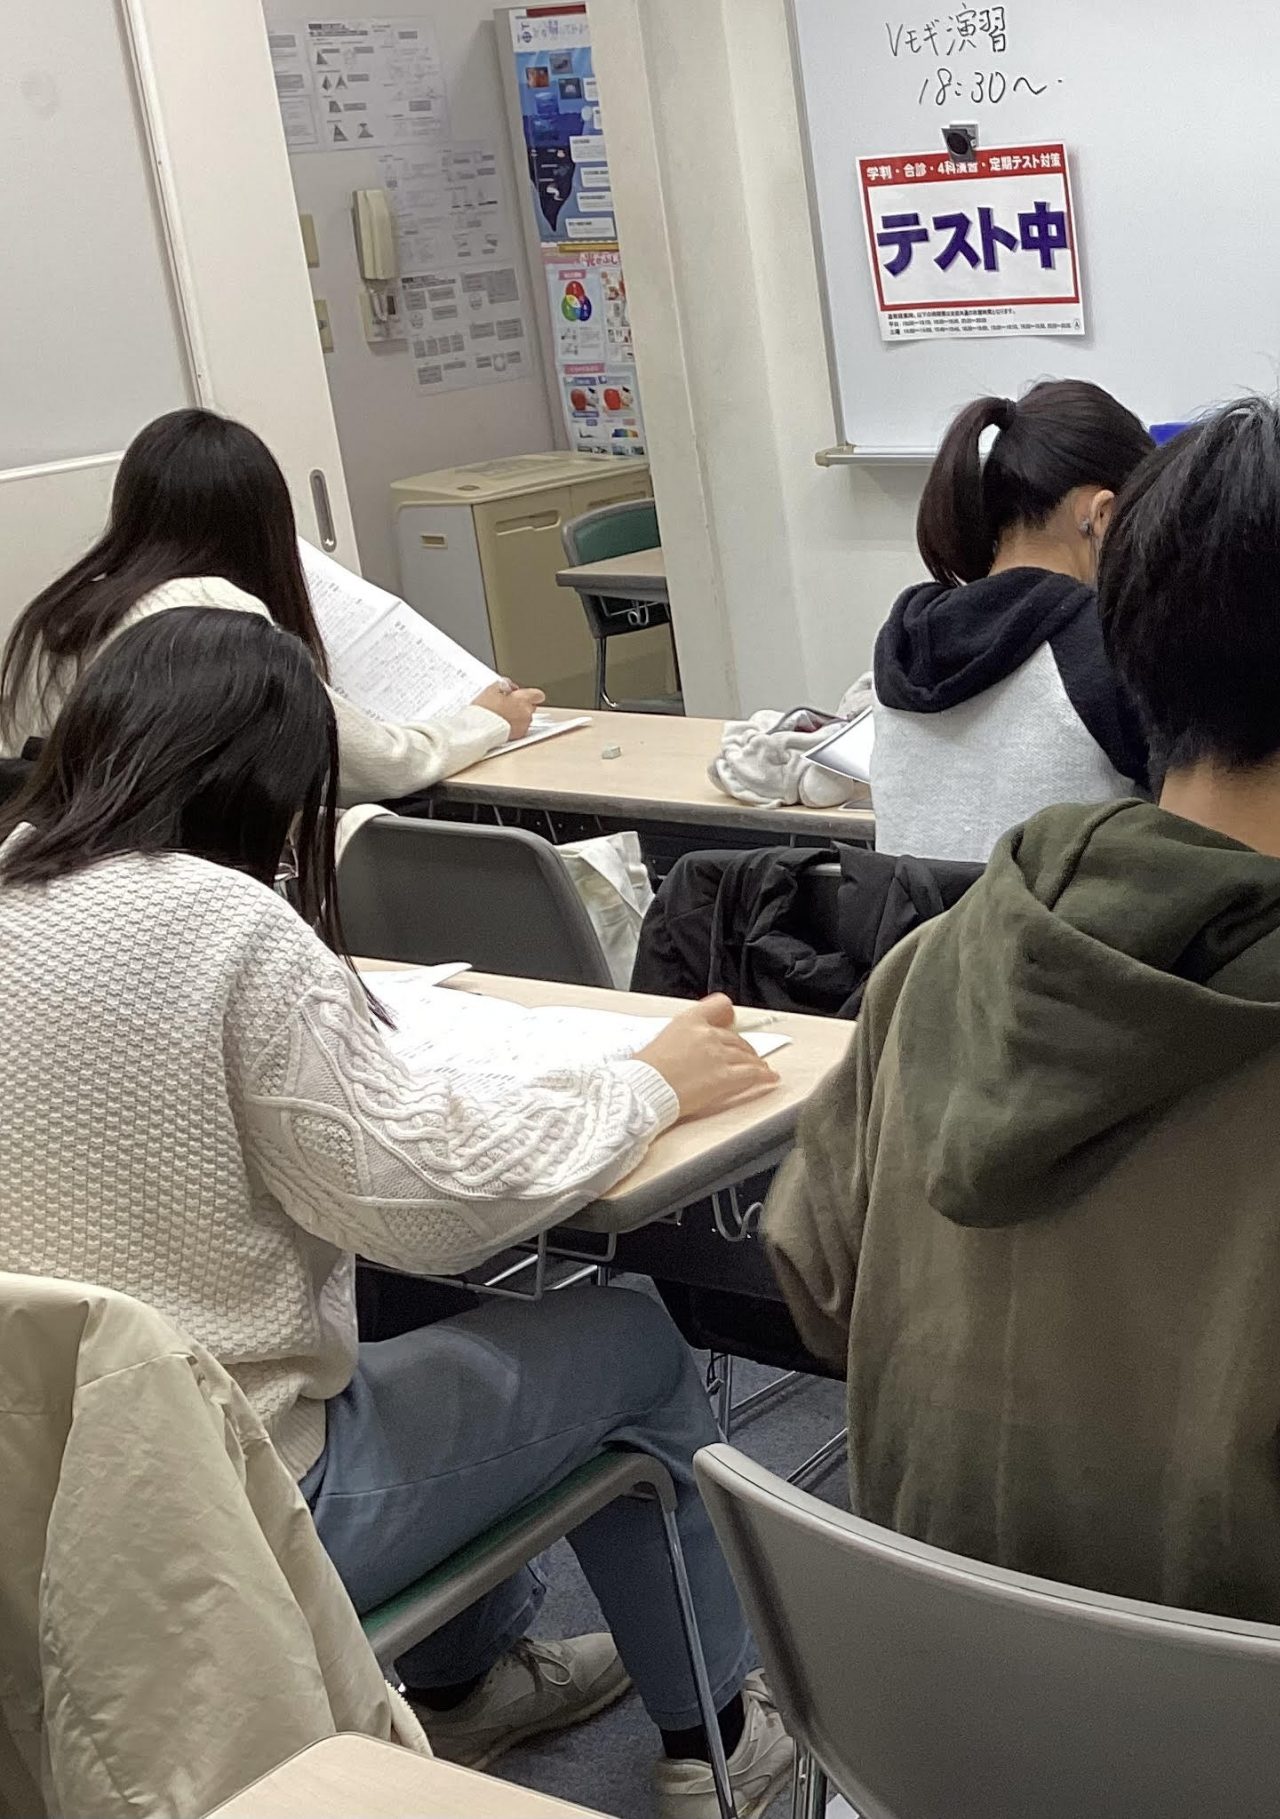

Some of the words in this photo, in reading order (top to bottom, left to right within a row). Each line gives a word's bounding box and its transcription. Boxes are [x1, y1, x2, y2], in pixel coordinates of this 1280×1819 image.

[885, 3, 1007, 57] Vモギ演習
[876, 201, 1068, 277] テスト中
